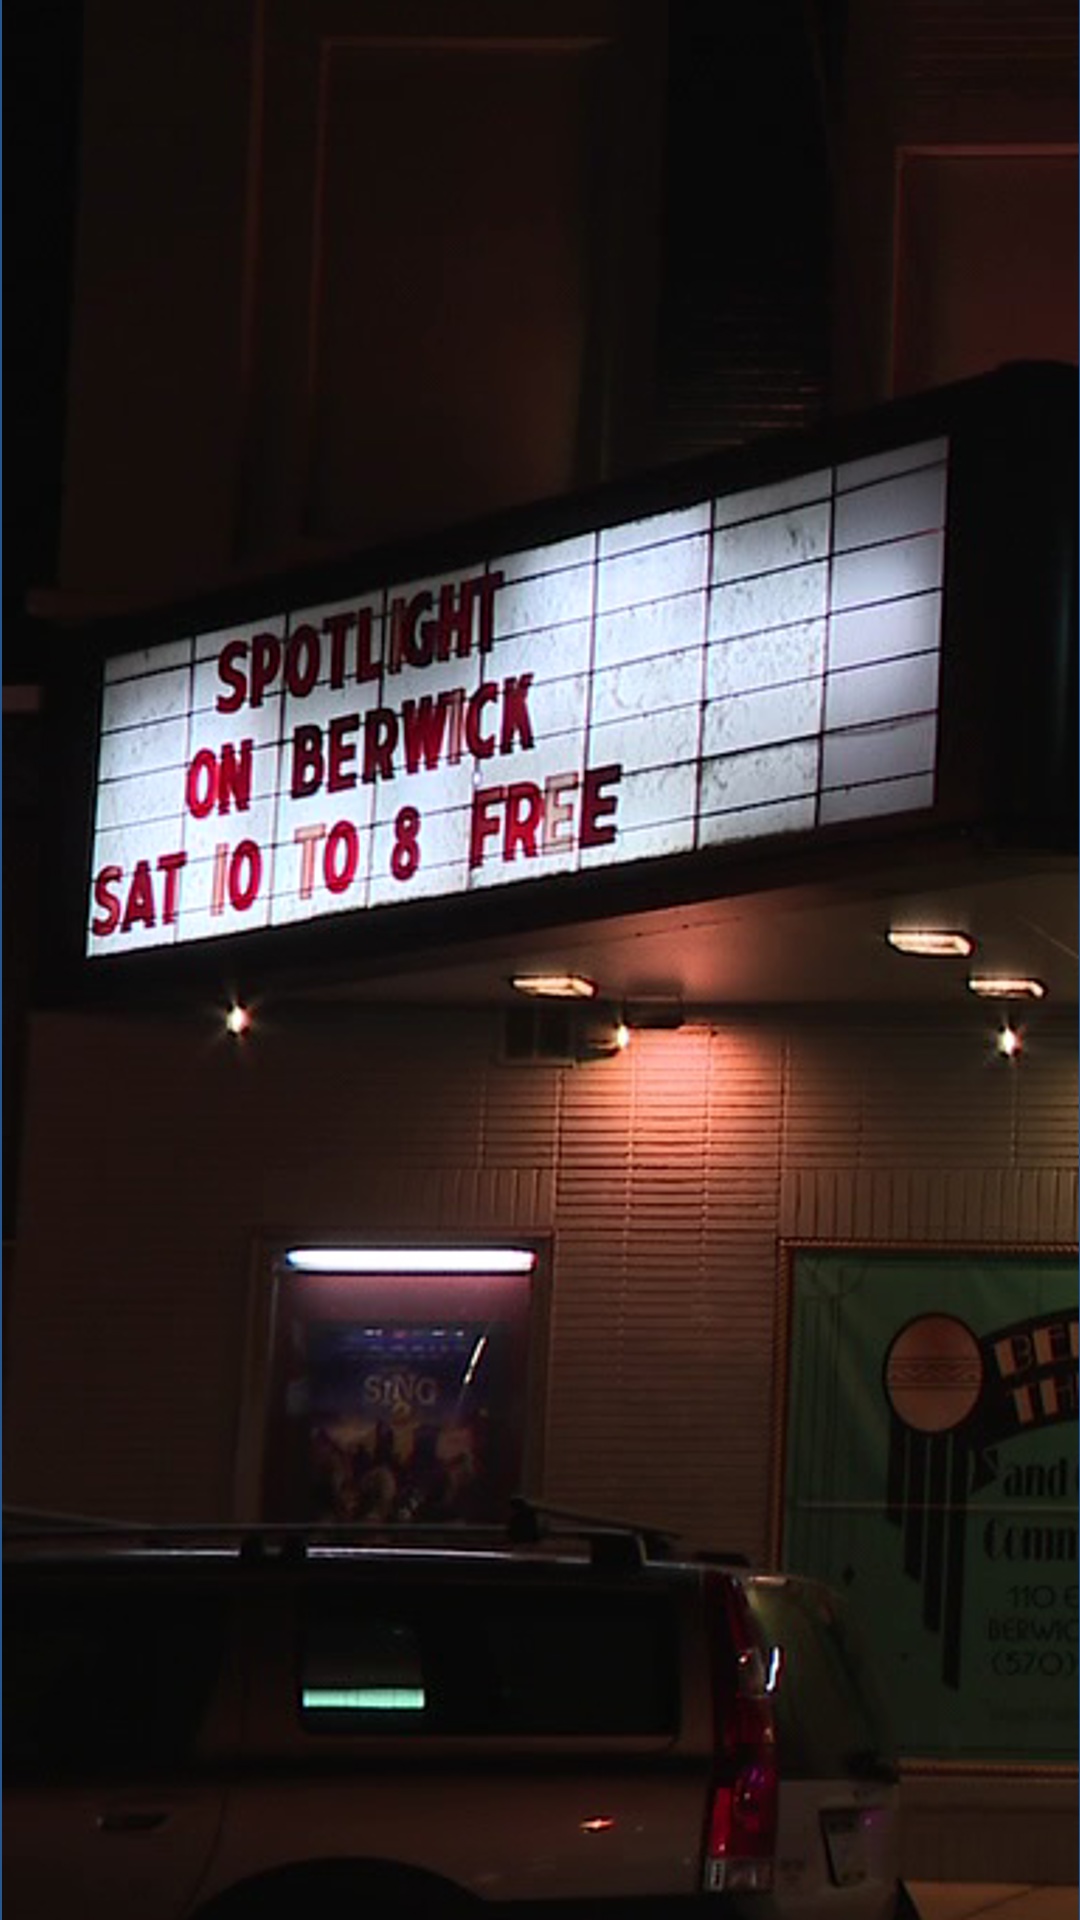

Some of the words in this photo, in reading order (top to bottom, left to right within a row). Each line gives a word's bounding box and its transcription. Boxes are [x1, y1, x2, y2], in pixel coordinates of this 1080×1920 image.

[215, 571, 504, 714] SPOTLIGHT
[184, 739, 253, 819] ON
[291, 673, 535, 799] BERWICK
[91, 851, 187, 937] SAT
[210, 840, 261, 917] 10
[293, 820, 359, 900] TO
[390, 806, 421, 881] 8
[468, 764, 622, 870] FREE
[1003, 1457, 1067, 1496] and
[1006, 1584, 1056, 1608] 110
[991, 1651, 1076, 1676] (570)
